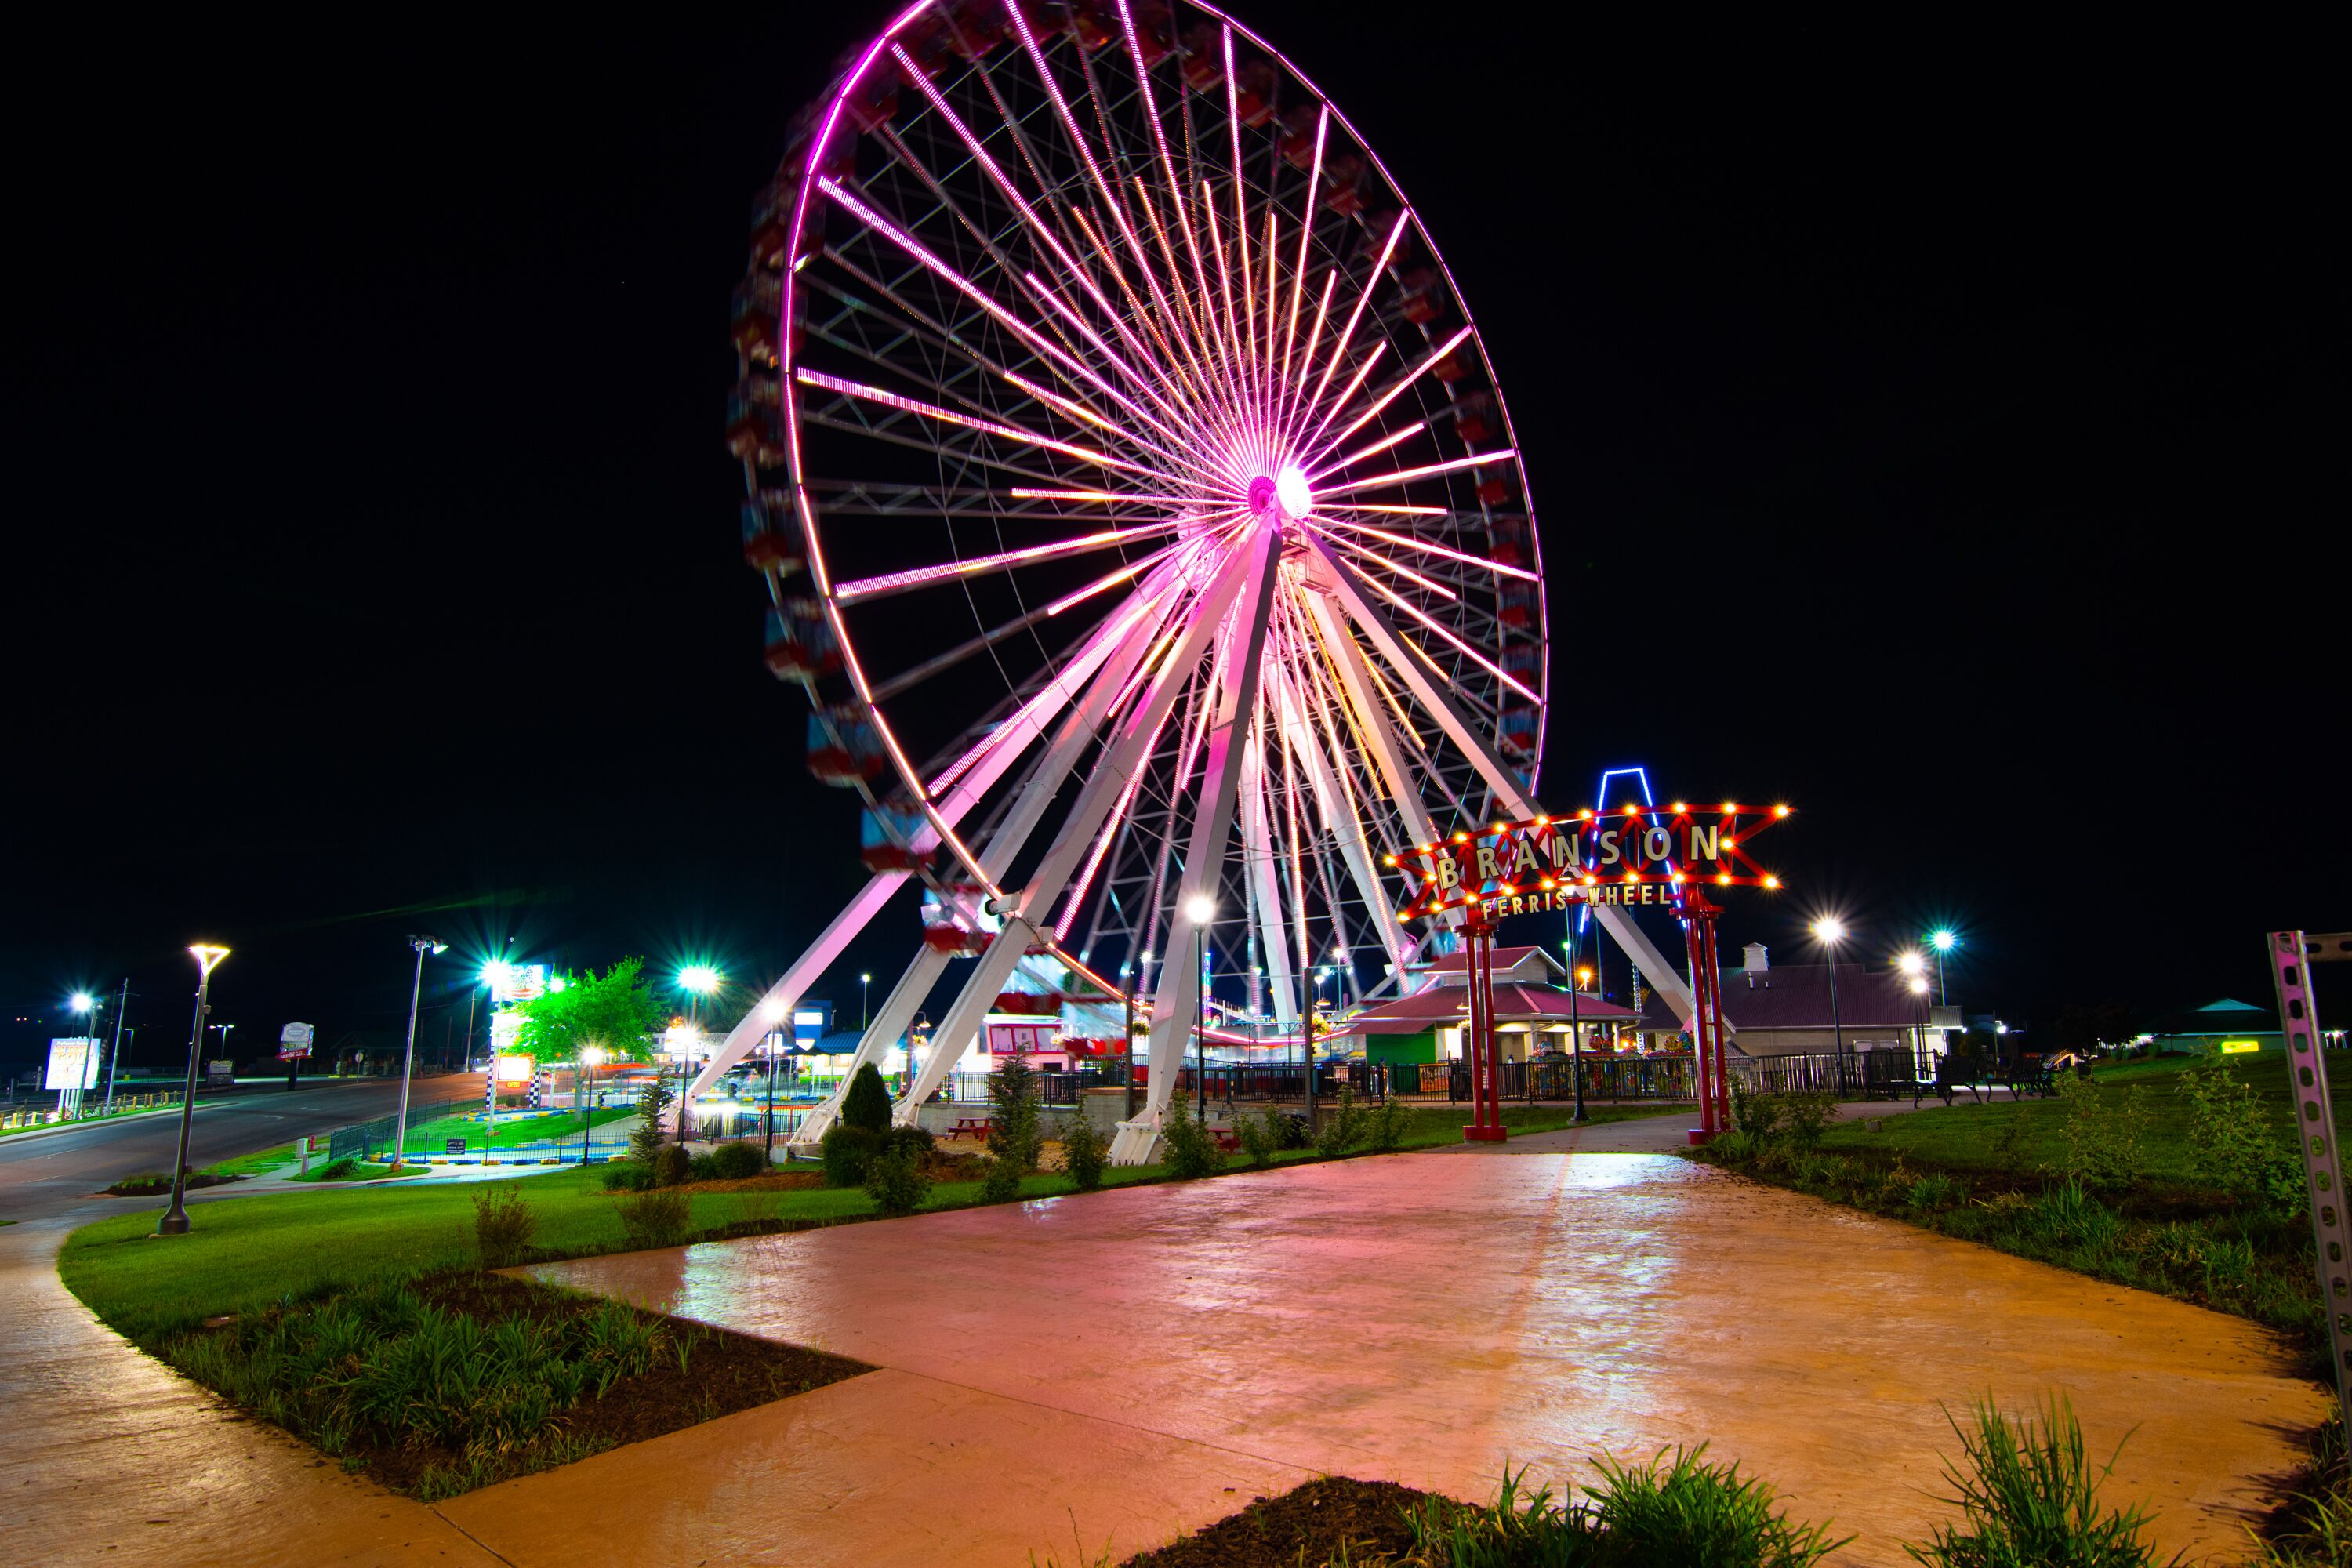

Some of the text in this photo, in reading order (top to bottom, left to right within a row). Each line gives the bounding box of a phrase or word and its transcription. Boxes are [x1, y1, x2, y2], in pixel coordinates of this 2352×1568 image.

[1438, 825, 1719, 891] BRANSON
[1482, 884, 1671, 921] FERRIS WHEEL
